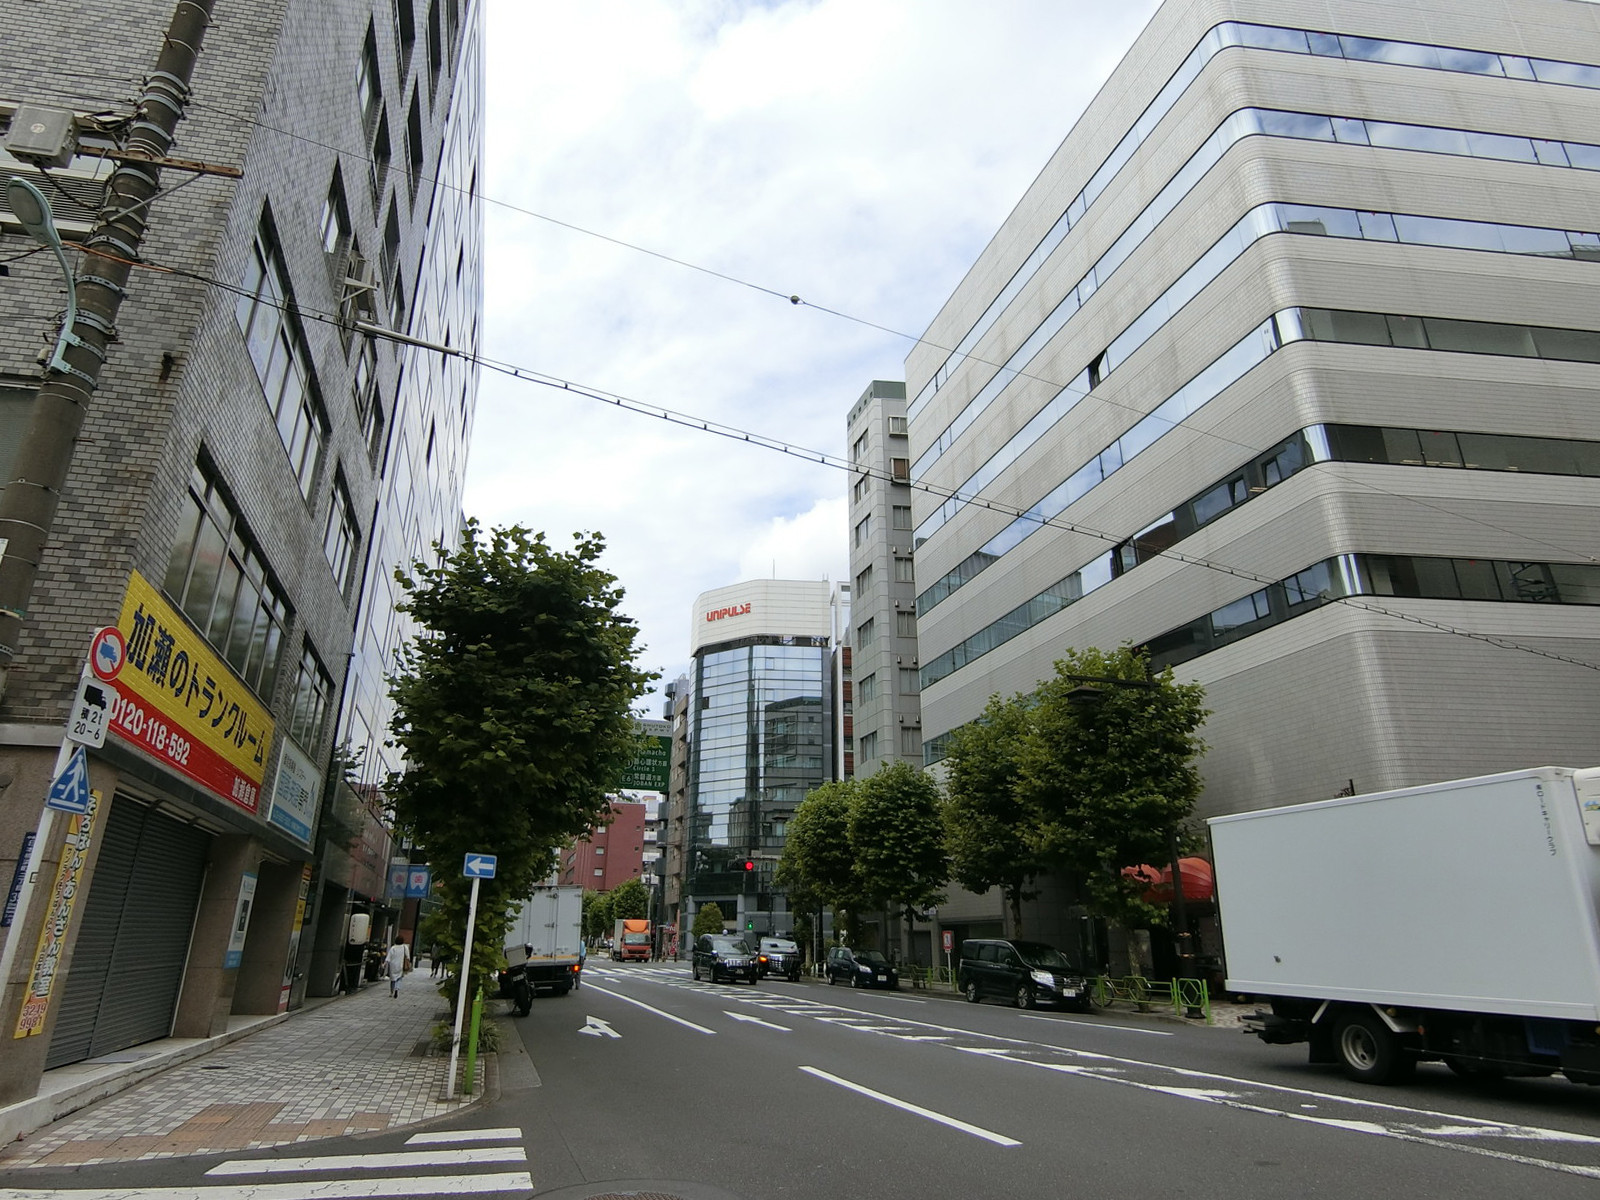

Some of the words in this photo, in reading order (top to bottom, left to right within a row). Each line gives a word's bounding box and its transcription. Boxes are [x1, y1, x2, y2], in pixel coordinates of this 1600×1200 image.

[706, 602, 751, 622] UNIPULSE
[126, 602, 265, 767] 加瀬のトランクルーム
[73, 721, 101, 740] 20-6
